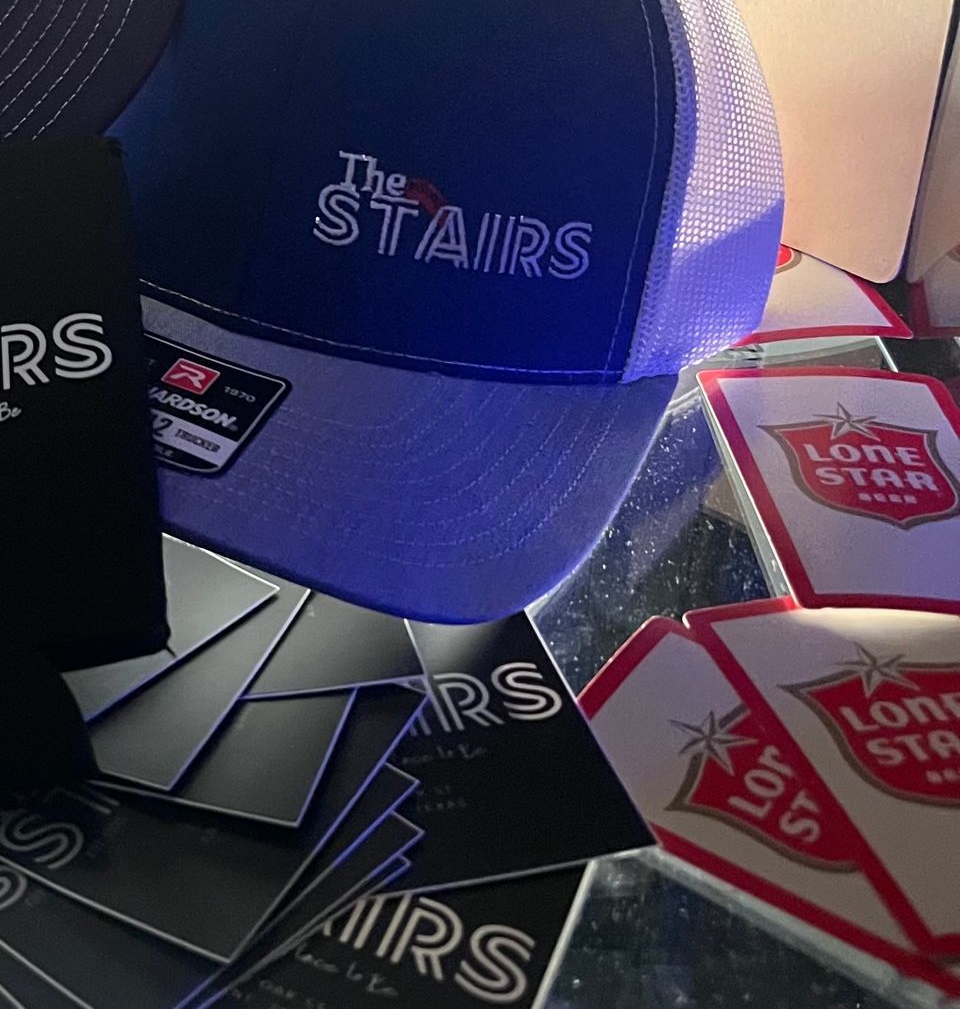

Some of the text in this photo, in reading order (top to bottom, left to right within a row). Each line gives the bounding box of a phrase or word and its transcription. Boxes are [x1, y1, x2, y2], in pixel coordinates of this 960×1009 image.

[339, 150, 407, 195] The
[313, 184, 593, 280] STAIRS
[223, 385, 257, 403] 1970
[803, 443, 926, 467] LONE
[815, 466, 940, 492] STAR
